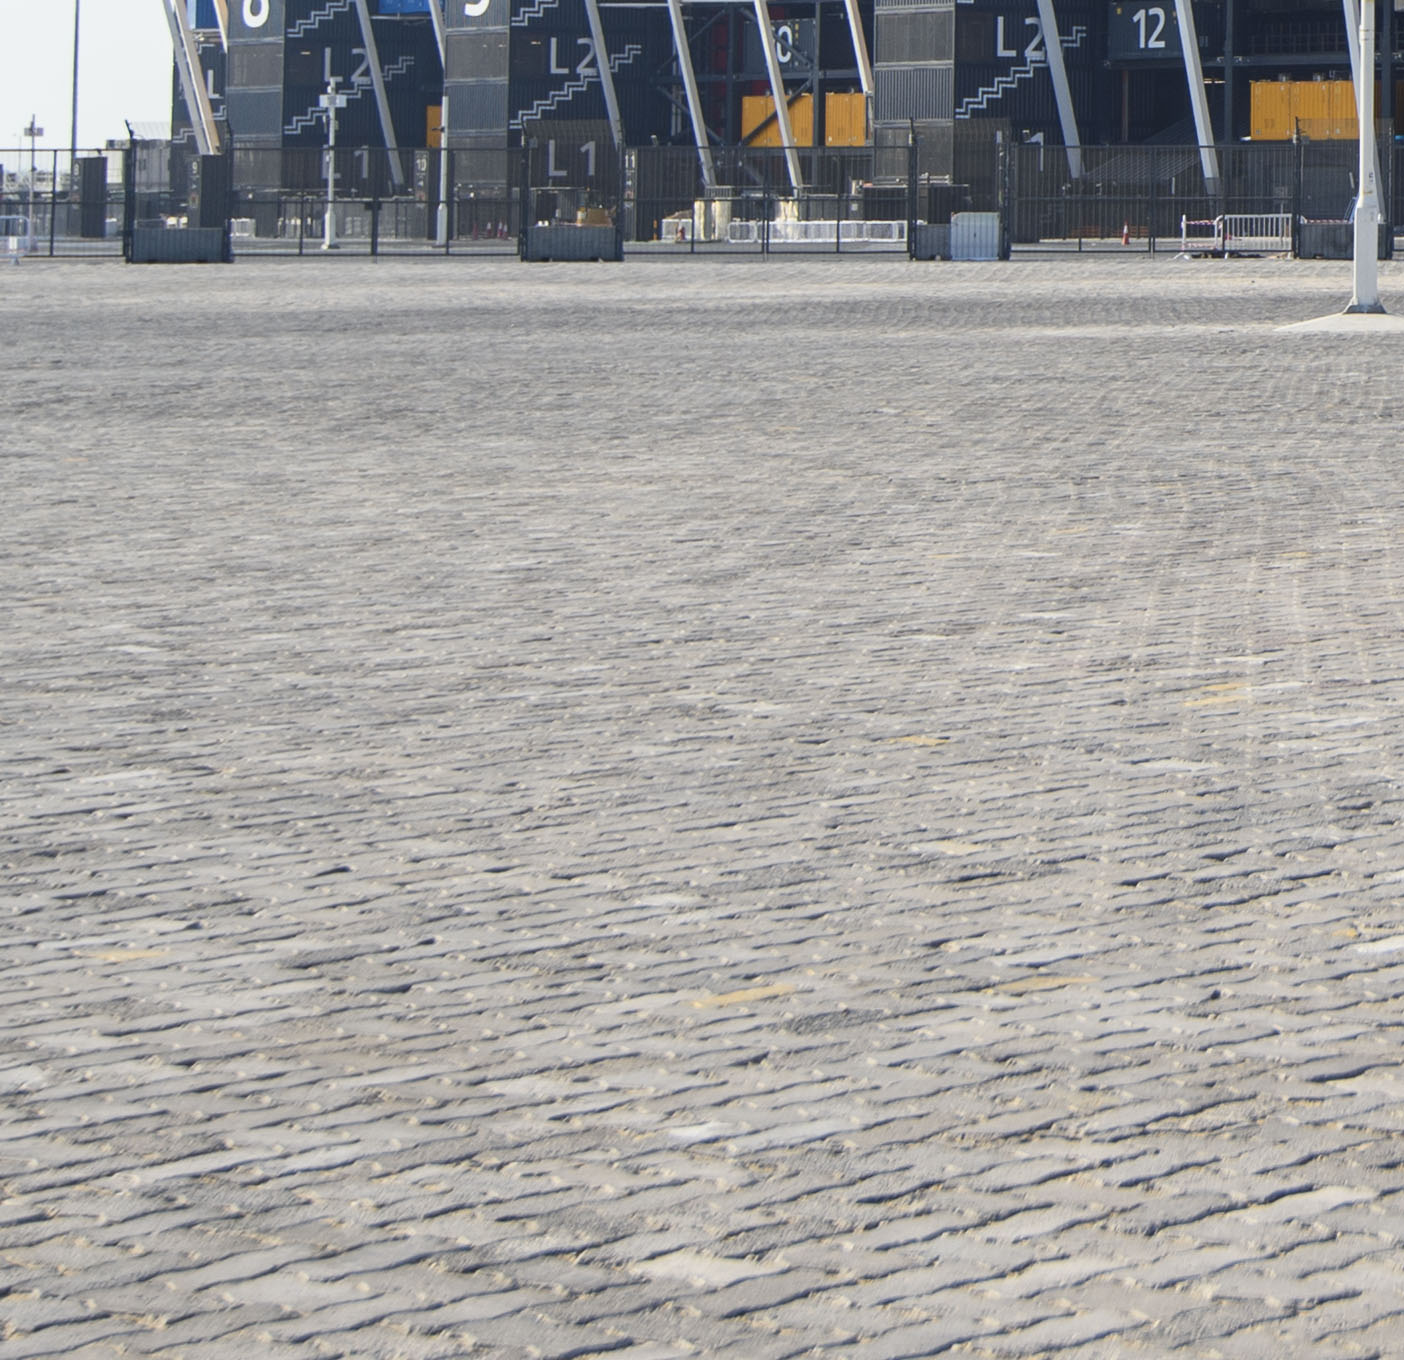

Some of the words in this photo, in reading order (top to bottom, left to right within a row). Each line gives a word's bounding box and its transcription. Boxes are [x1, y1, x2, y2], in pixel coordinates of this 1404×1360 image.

[997, 16, 1046, 58] L2
[1132, 6, 1166, 49] 12
[324, 47, 371, 83] L2
[550, 37, 597, 74] L2
[548, 139, 597, 177] L1
